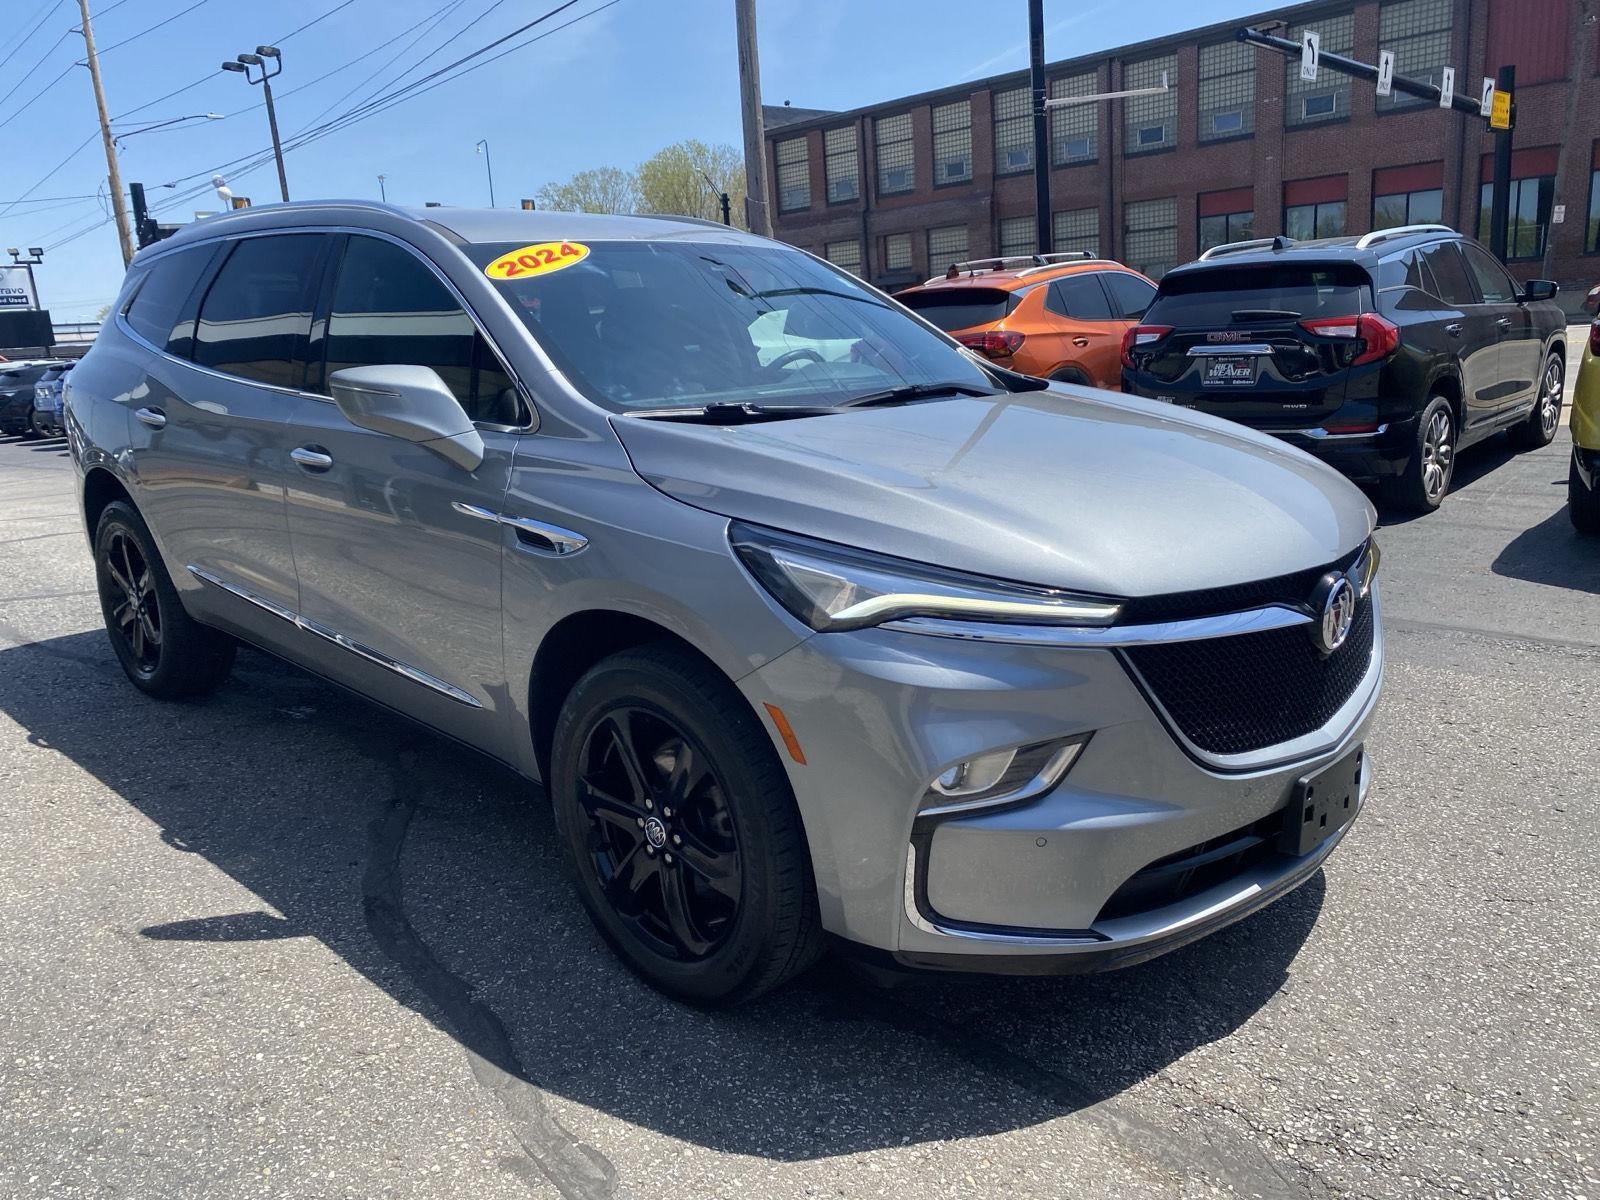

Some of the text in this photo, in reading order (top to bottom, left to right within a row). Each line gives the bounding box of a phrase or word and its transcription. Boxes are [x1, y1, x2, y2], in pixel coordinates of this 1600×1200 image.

[1302, 66, 1315, 77] ONLY
[497, 242, 580, 277] 2024
[1206, 331, 1251, 342] GMC
[1209, 368, 1251, 377] WEAVER
